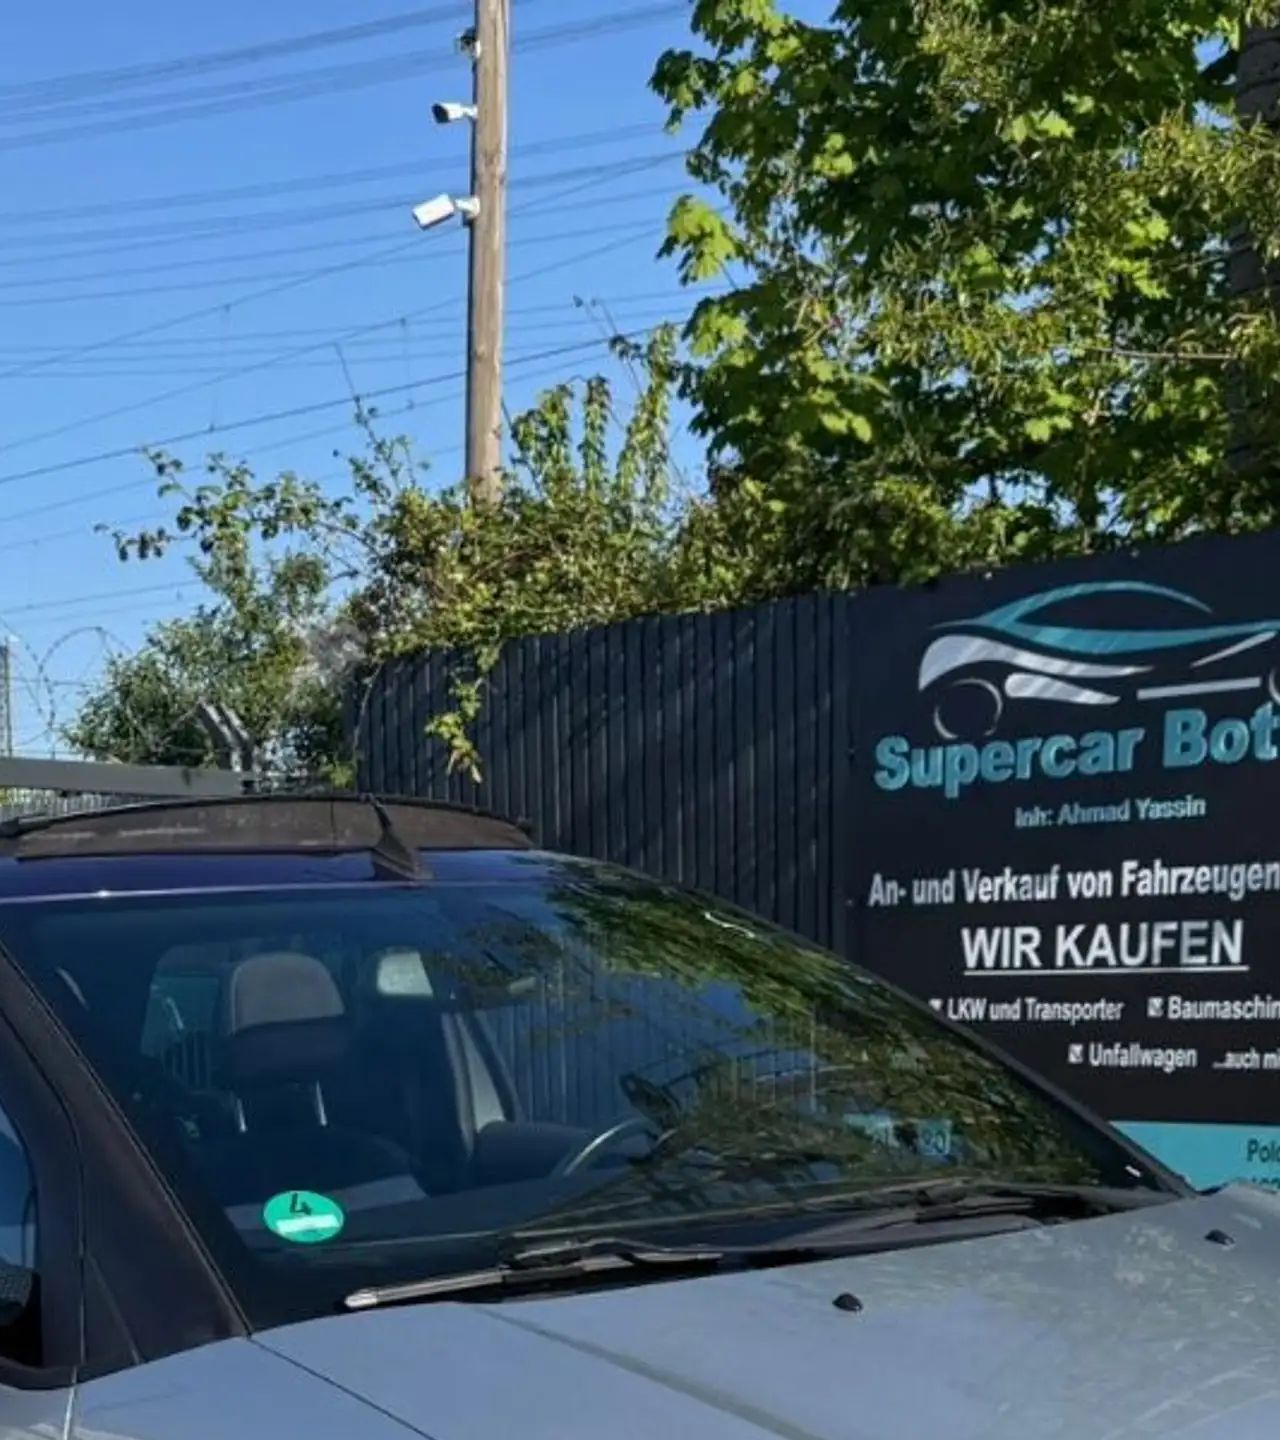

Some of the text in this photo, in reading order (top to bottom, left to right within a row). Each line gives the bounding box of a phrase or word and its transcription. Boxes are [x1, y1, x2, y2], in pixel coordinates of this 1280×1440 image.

[874, 727, 1145, 798] Supercar
[1015, 795, 1206, 828] Inh: Ahmad Yassin
[869, 873, 907, 907] An-
[913, 869, 955, 904] und
[962, 864, 1061, 902] Verkauf
[1066, 870, 1113, 899] von
[961, 919, 1243, 968] WIR KAUFEN
[947, 998, 987, 1021] LKW
[989, 998, 1020, 1021] und
[1024, 997, 1124, 1026] Transporter
[1089, 1042, 1197, 1073] Unfallwagen
[289, 1192, 312, 1215] 4
